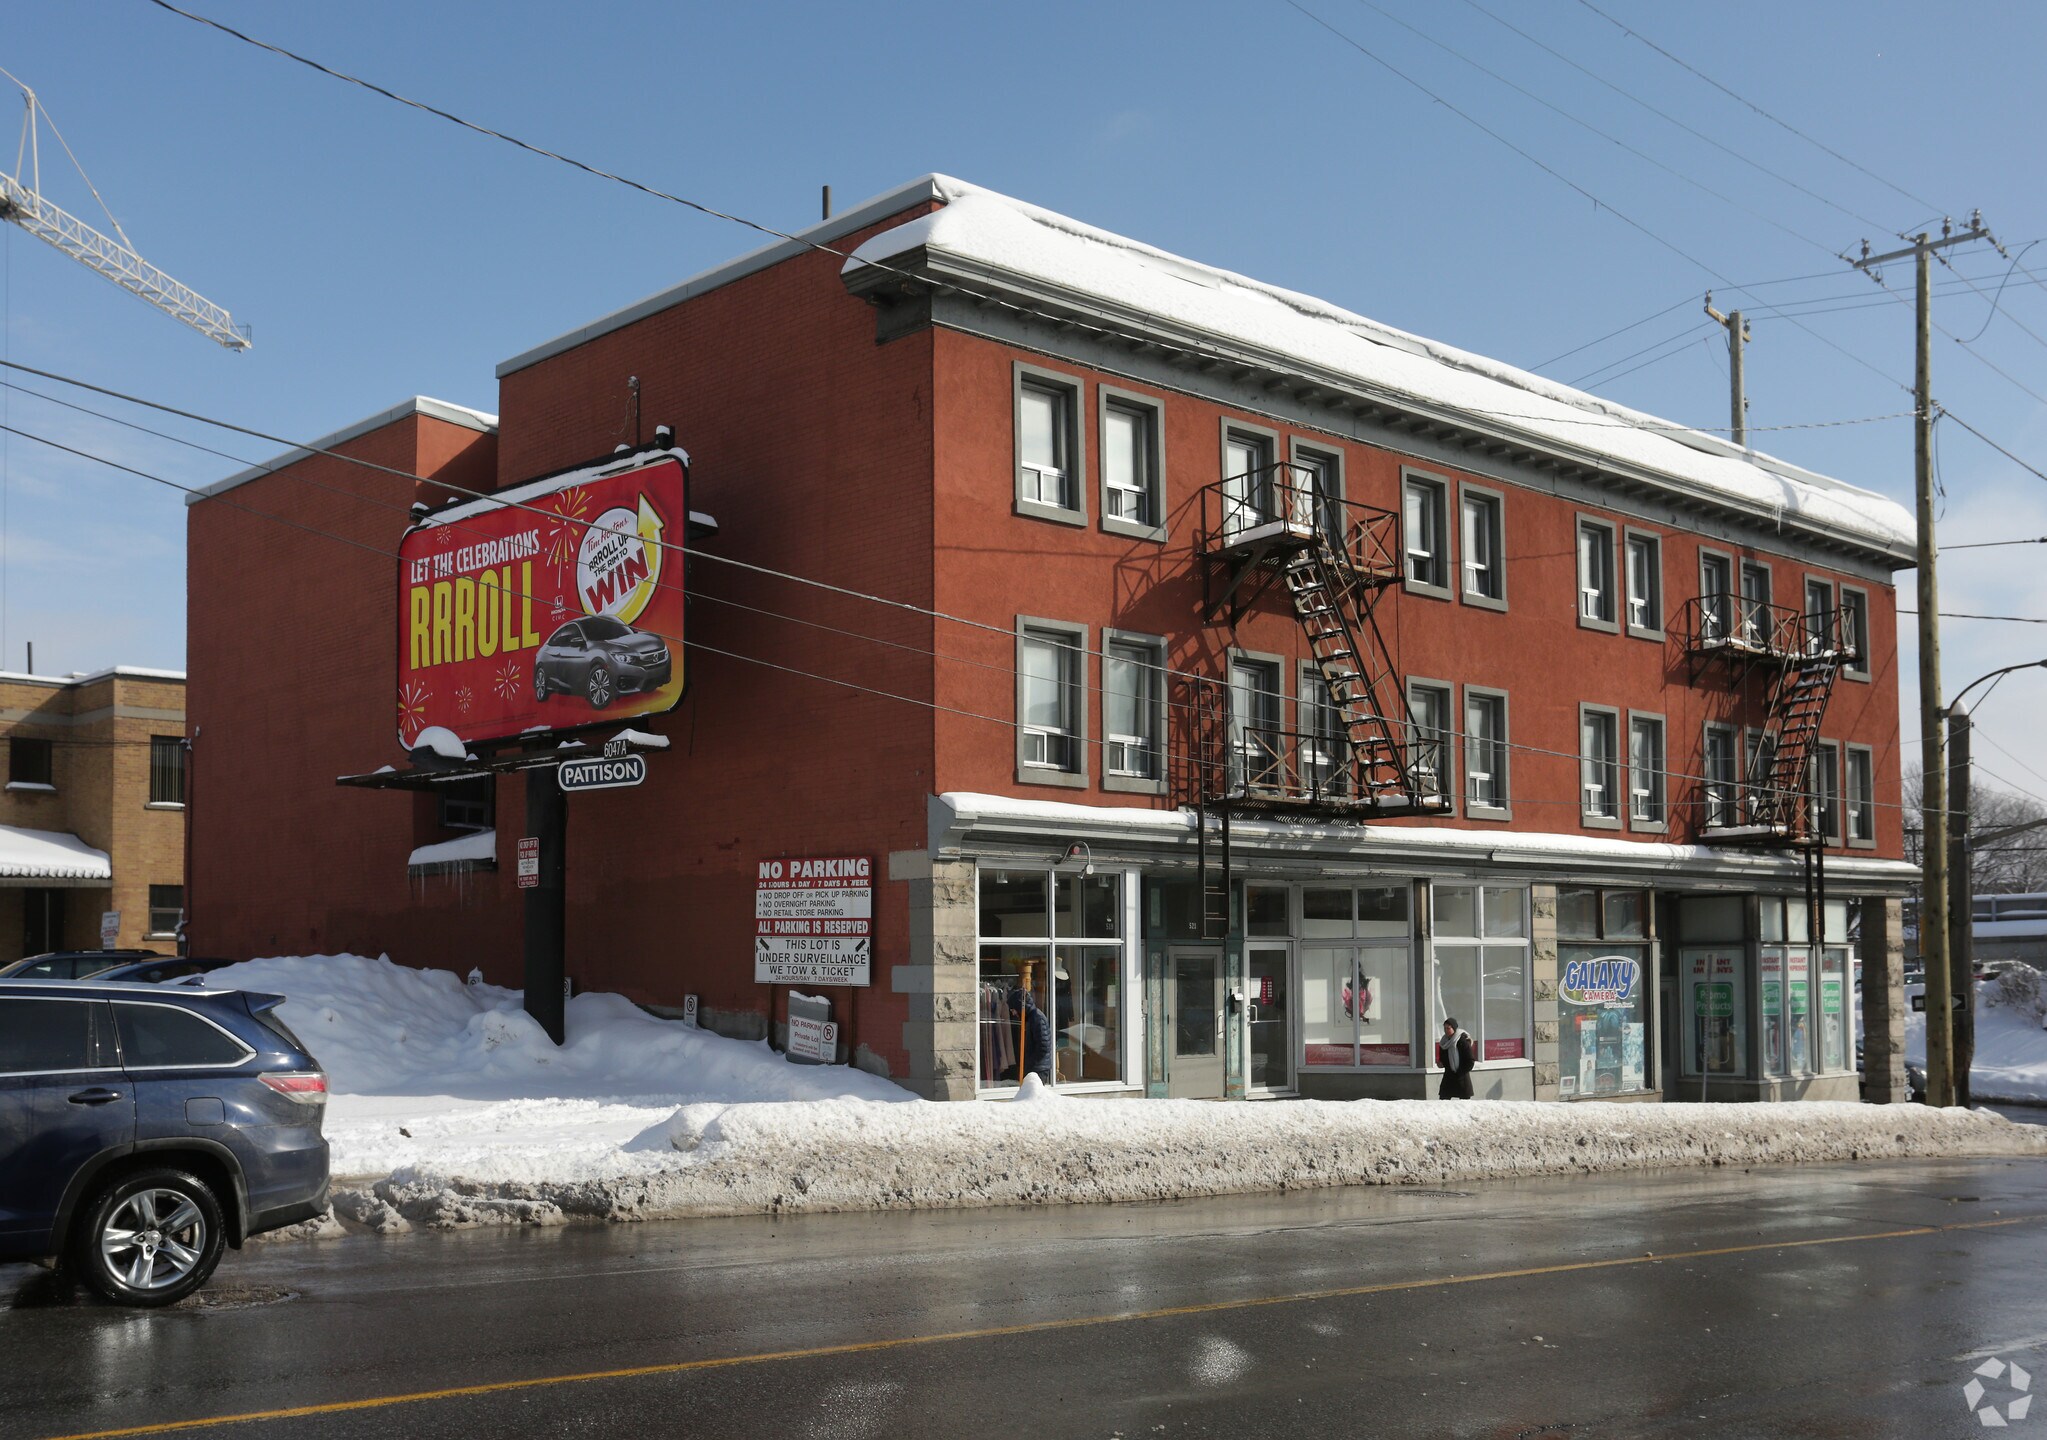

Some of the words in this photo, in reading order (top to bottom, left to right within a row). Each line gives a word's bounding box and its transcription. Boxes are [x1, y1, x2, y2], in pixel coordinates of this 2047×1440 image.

[586, 536, 600, 553] Tim
[589, 540, 618, 571] RRROLL
[618, 534, 629, 547] UP
[411, 557, 430, 583] LET
[433, 551, 453, 578] THE
[456, 529, 540, 573] CELEBRATIONS
[594, 564, 607, 577] THE
[608, 554, 620, 567] RIM
[619, 548, 628, 558] TO
[585, 546, 650, 614] WIN
[411, 560, 540, 670] RRROLL
[604, 740, 627, 758] 6047A
[565, 762, 638, 784] PATTISON
[759, 862, 783, 879] NO
[790, 858, 869, 878] PARKING
[758, 921, 771, 933] ALL
[774, 921, 810, 934] PARKING
[813, 921, 821, 933] IS
[824, 920, 868, 934] RESERVED
[785, 939, 806, 950] THIS
[810, 940, 828, 950] LOT
[832, 940, 840, 950] IS
[760, 952, 790, 963] UNDER
[793, 953, 866, 964] SURVEILLANCE
[769, 965, 783, 974] WE
[787, 966, 807, 975] TOW
[811, 966, 817, 975] &
[822, 966, 855, 976] TICKET
[1566, 961, 1634, 999] GALAXY
[1583, 990, 1616, 1001] CAMERA
[1700, 990, 1727, 999] Pomo
[1697, 1000, 1731, 1010] Prducts
[791, 1019, 799, 1027] NO
[800, 1021, 820, 1031] PARKIN
[794, 1032, 810, 1041] Private
